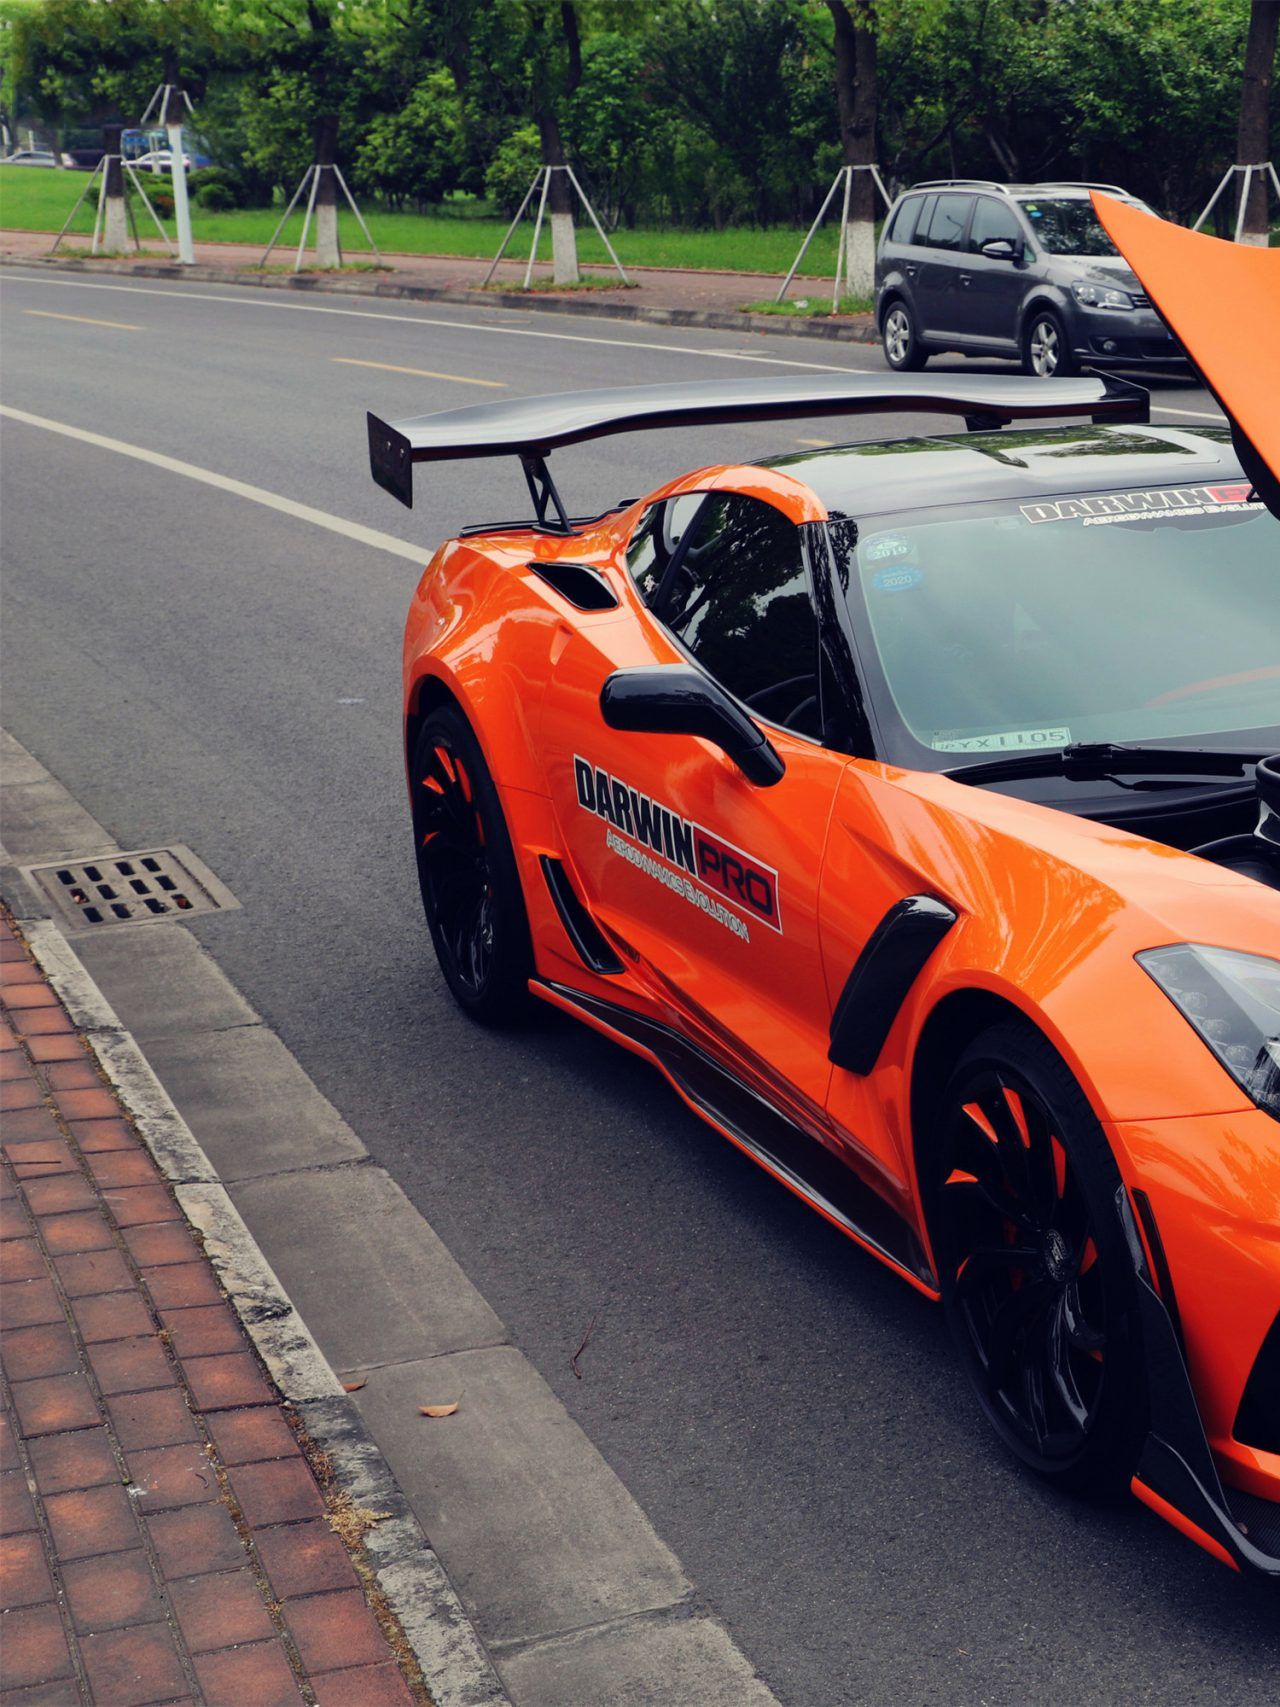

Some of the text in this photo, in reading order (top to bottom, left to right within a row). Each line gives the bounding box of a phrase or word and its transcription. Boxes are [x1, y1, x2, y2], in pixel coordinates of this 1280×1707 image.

[1019, 487, 1219, 525] DARWIN
[882, 575, 913, 588] 2020
[573, 752, 773, 917] DARWIN PRO
